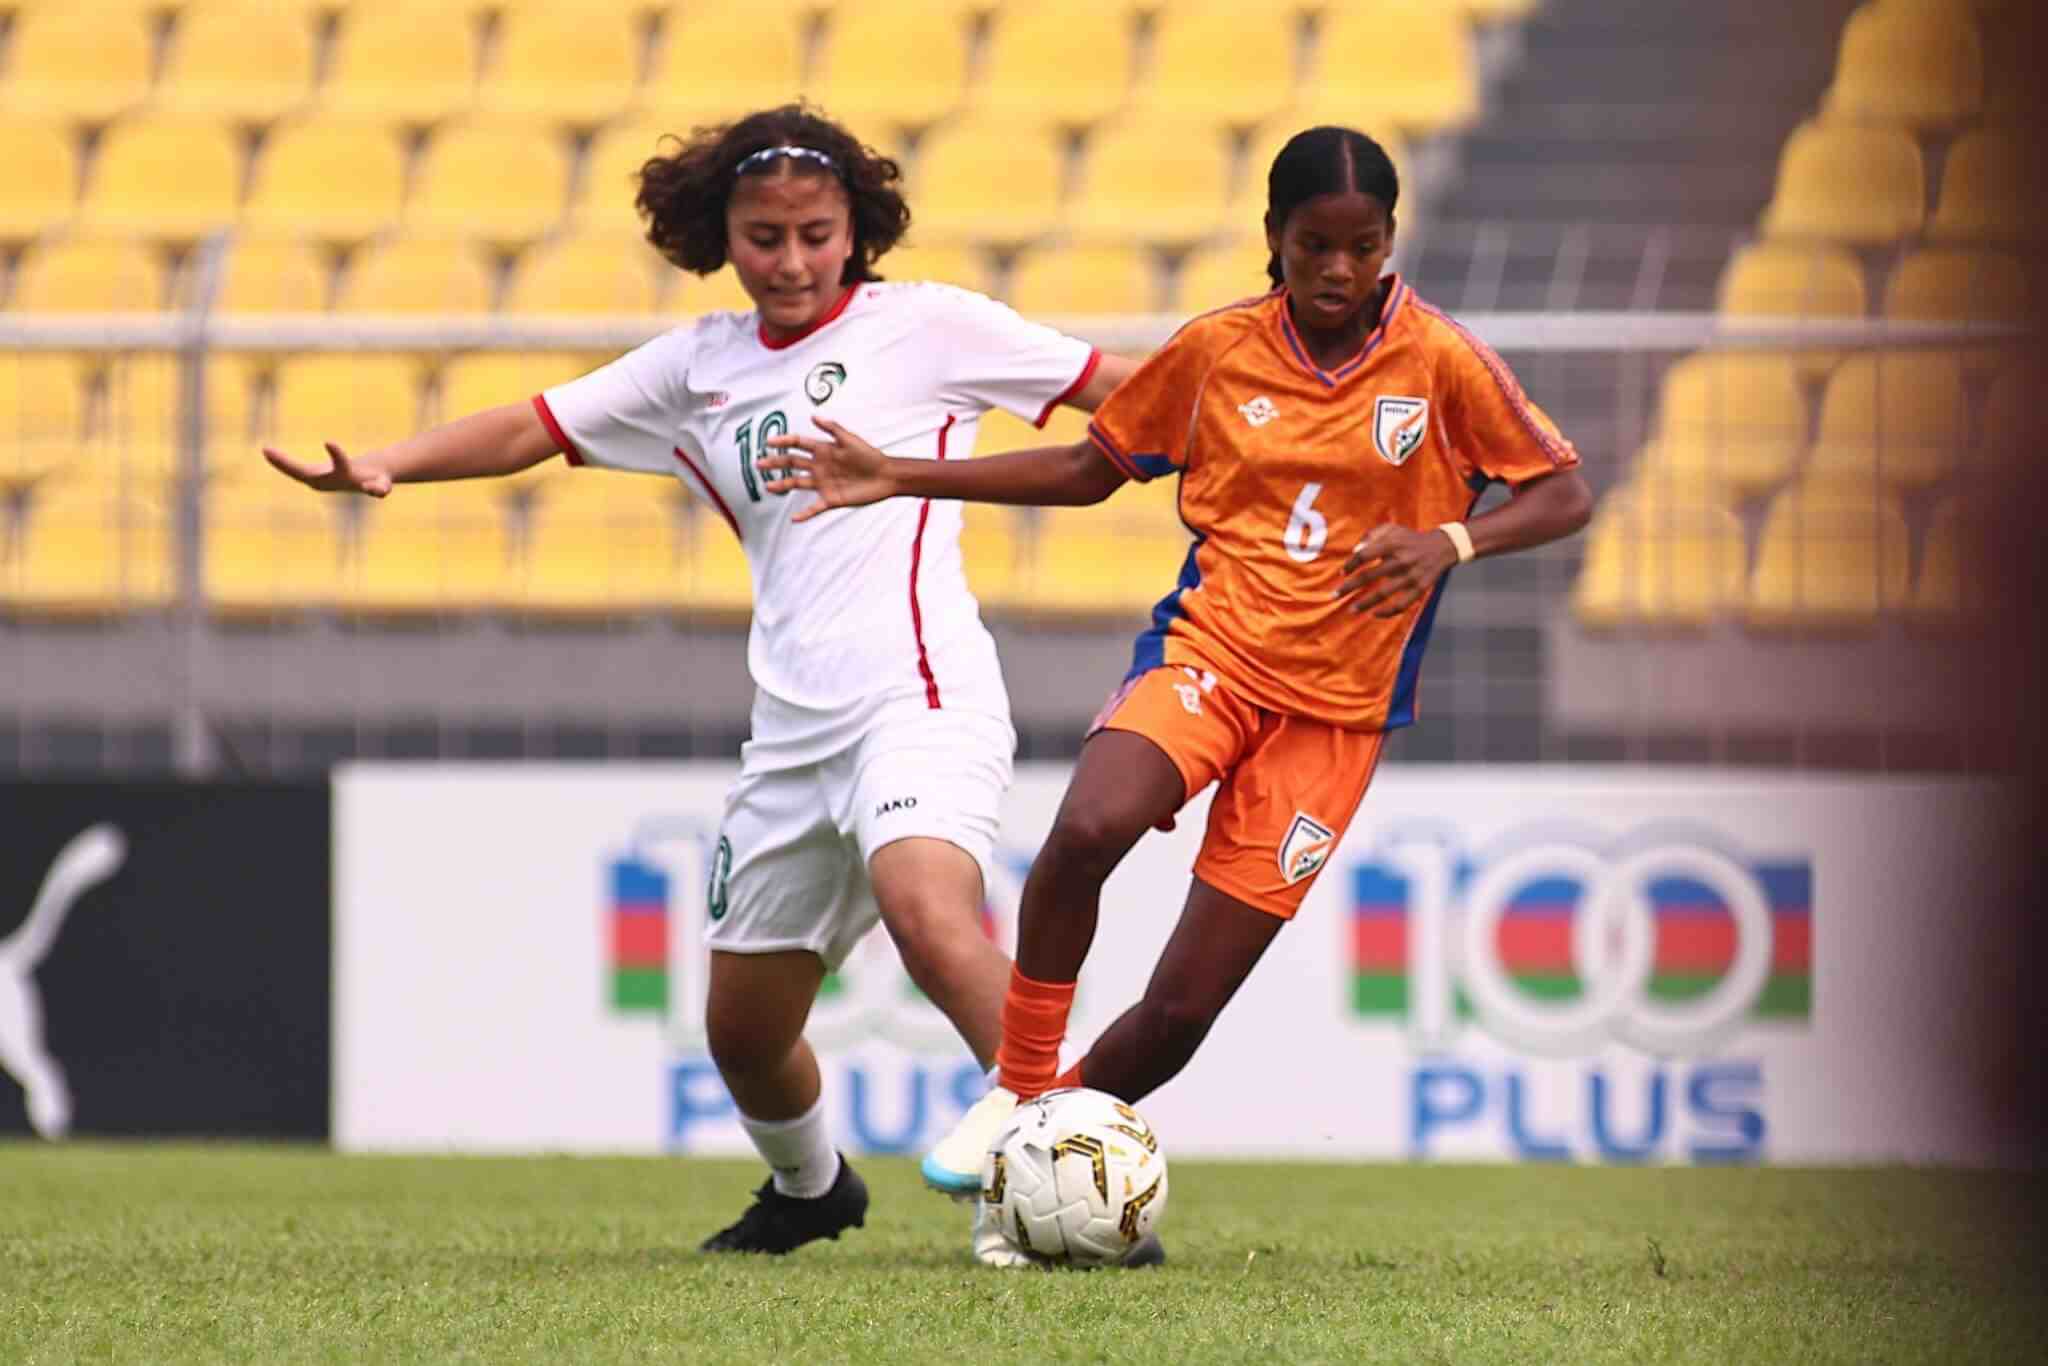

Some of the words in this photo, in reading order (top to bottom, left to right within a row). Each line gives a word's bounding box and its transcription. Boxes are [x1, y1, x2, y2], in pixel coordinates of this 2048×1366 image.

[1283, 482, 1328, 563] 6
[875, 797, 918, 817] JAKO
[1372, 822, 1782, 1050] 100
[1411, 1062, 1766, 1162] PLUS
